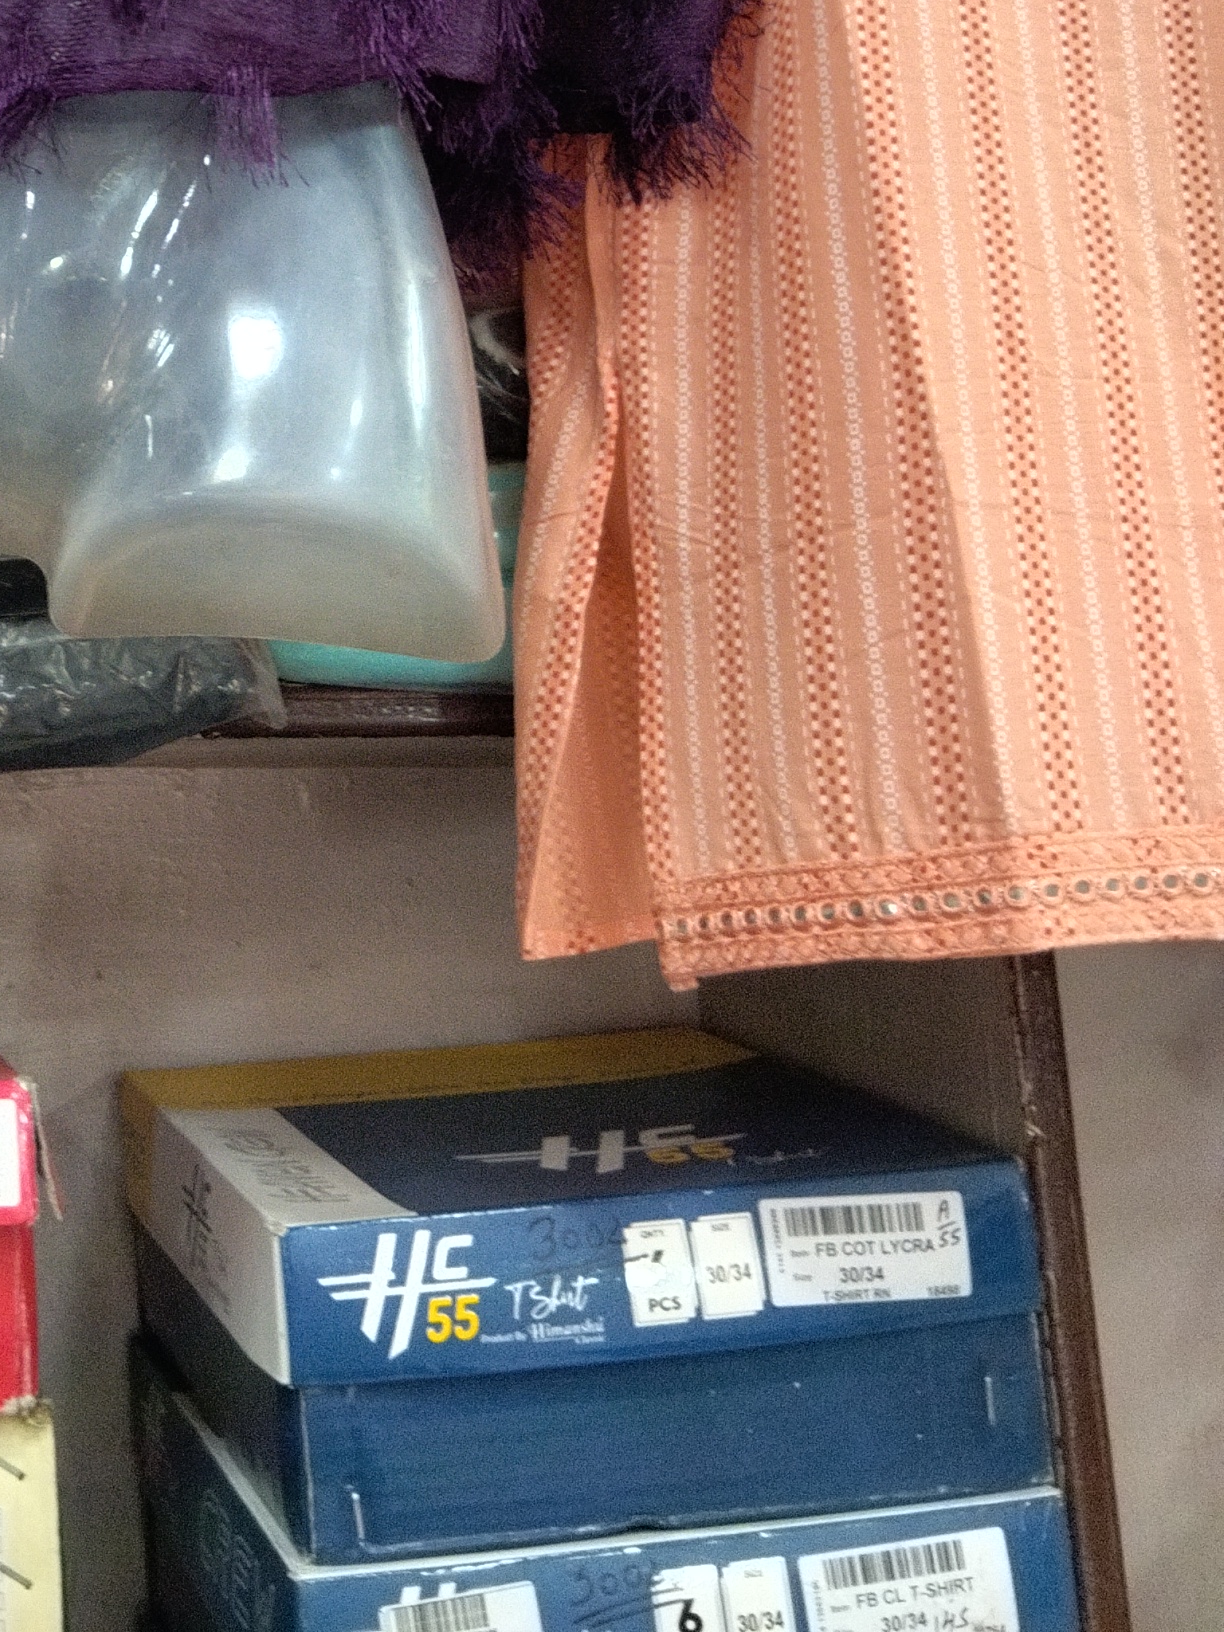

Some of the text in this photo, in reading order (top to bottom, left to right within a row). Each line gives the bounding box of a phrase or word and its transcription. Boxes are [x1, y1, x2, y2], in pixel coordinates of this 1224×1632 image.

[815, 1238, 936, 1258] FB COT LYCRA
[705, 1262, 753, 1285] 30/34
[839, 1266, 886, 1284] 30/34
[648, 1295, 682, 1312] PCS
[426, 1293, 480, 1344] 55
[855, 1576, 975, 1610] FB CL T-SHIRT
[678, 1598, 704, 1632] 6
[881, 1610, 929, 1632] 30/34
